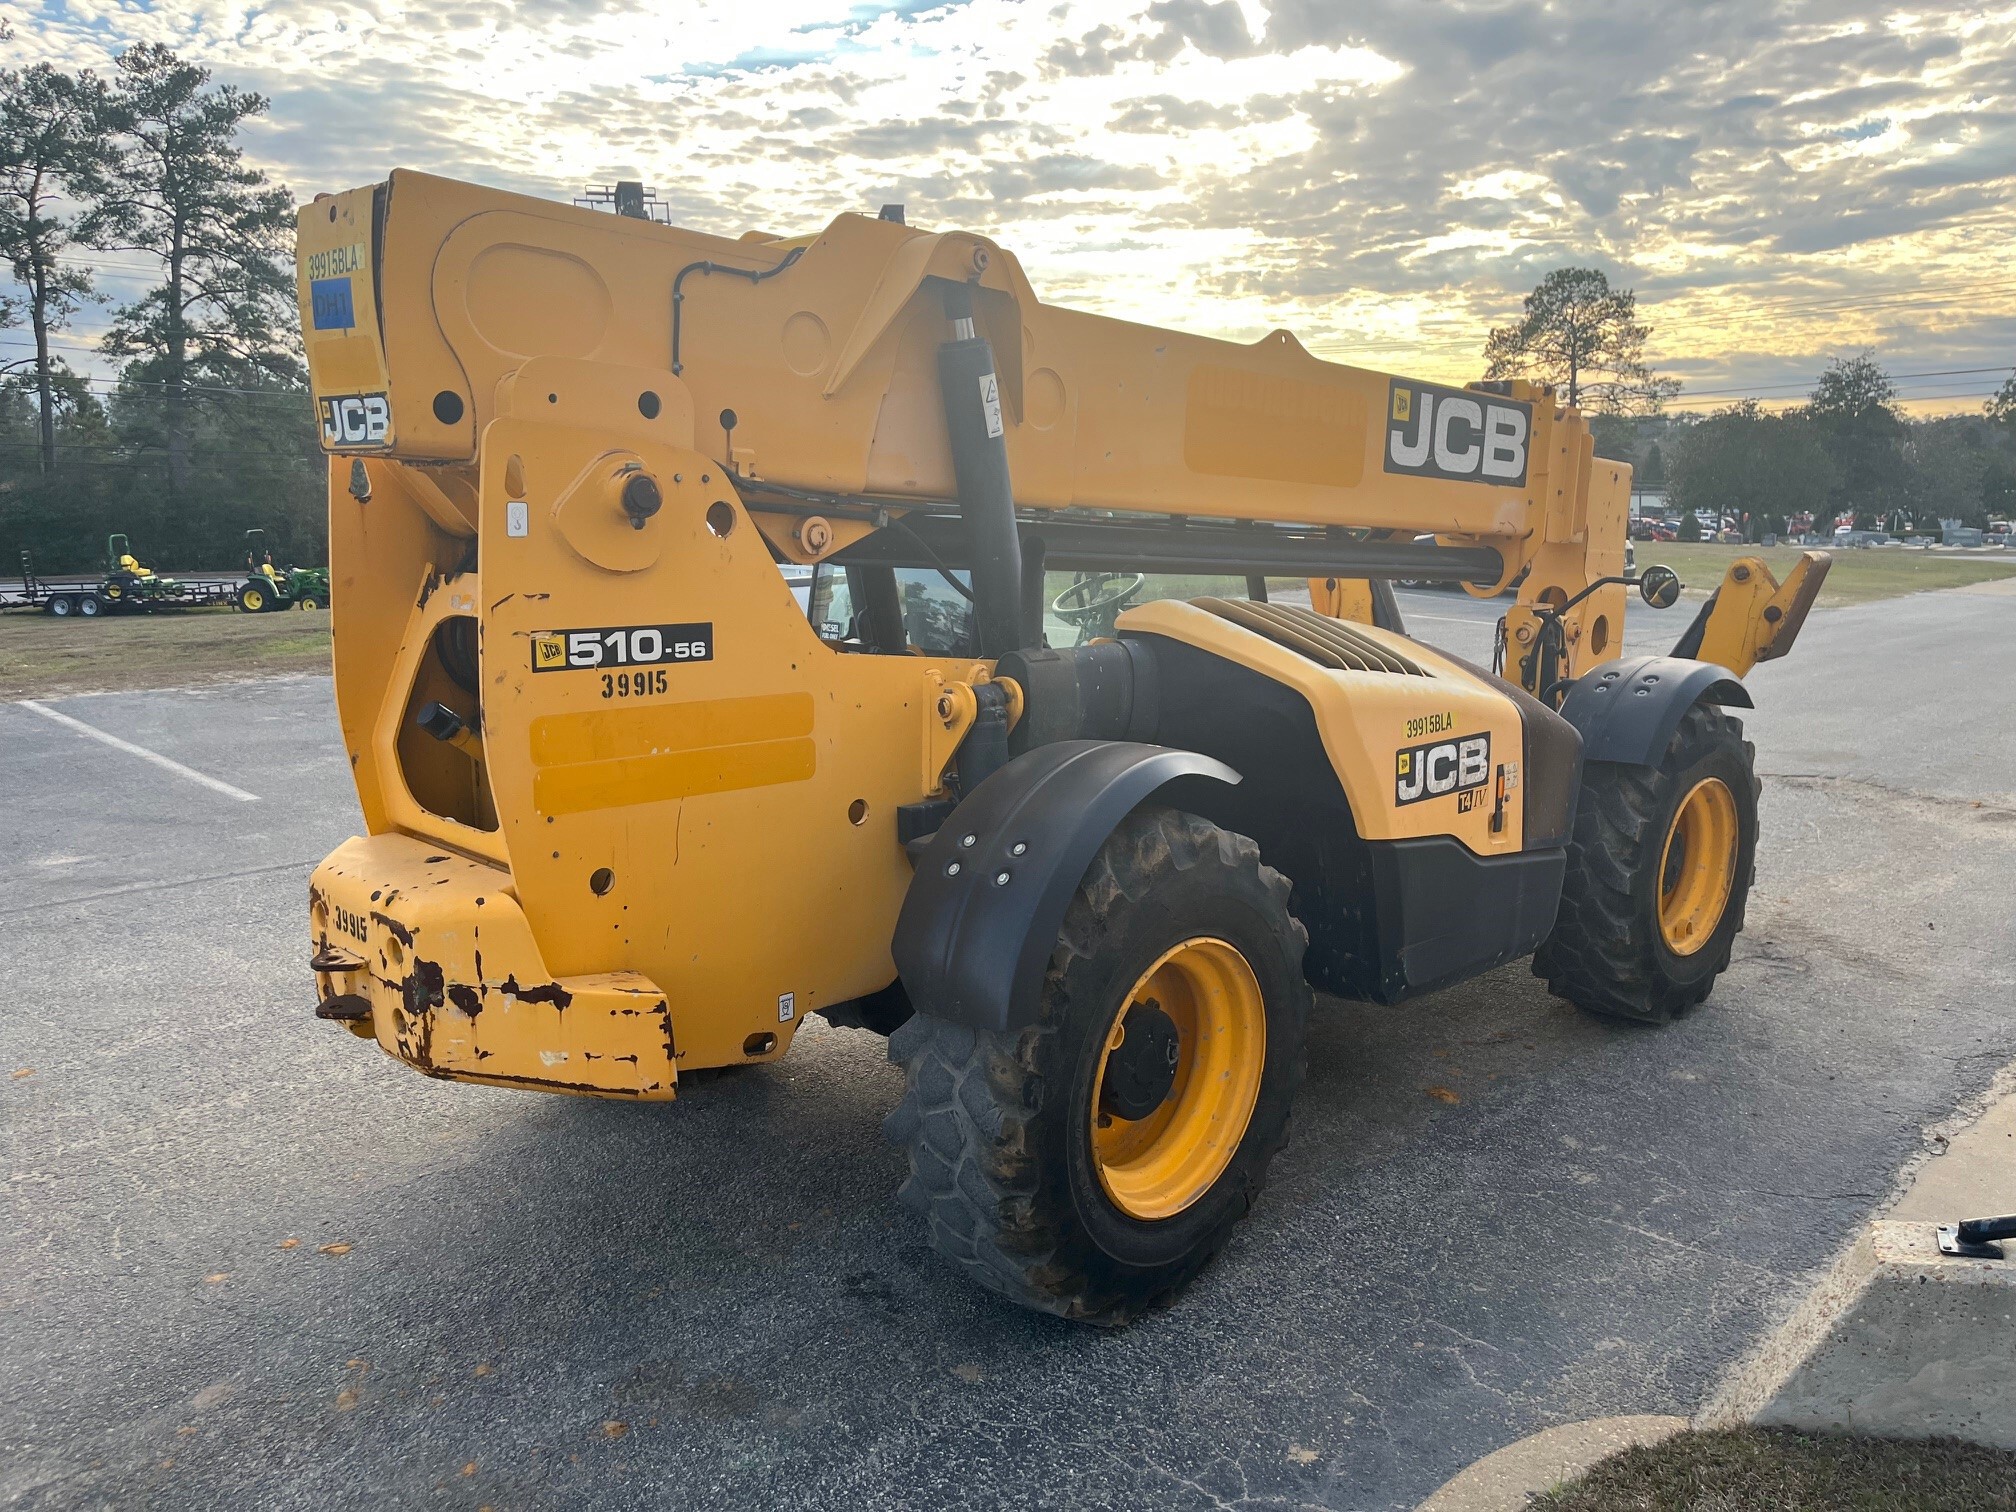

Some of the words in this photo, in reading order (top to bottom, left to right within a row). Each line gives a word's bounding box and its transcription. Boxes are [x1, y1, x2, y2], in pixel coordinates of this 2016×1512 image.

[308, 250, 359, 279] 39915BLA
[325, 397, 390, 442] JCB
[1390, 392, 1527, 479] JCB
[543, 643, 561, 659] JCB
[601, 670, 668, 698] 39915
[1406, 711, 1453, 739] 39915BLA
[1398, 737, 1488, 801] JCB
[1459, 793, 1473, 812] T4
[335, 905, 368, 943] 39915
